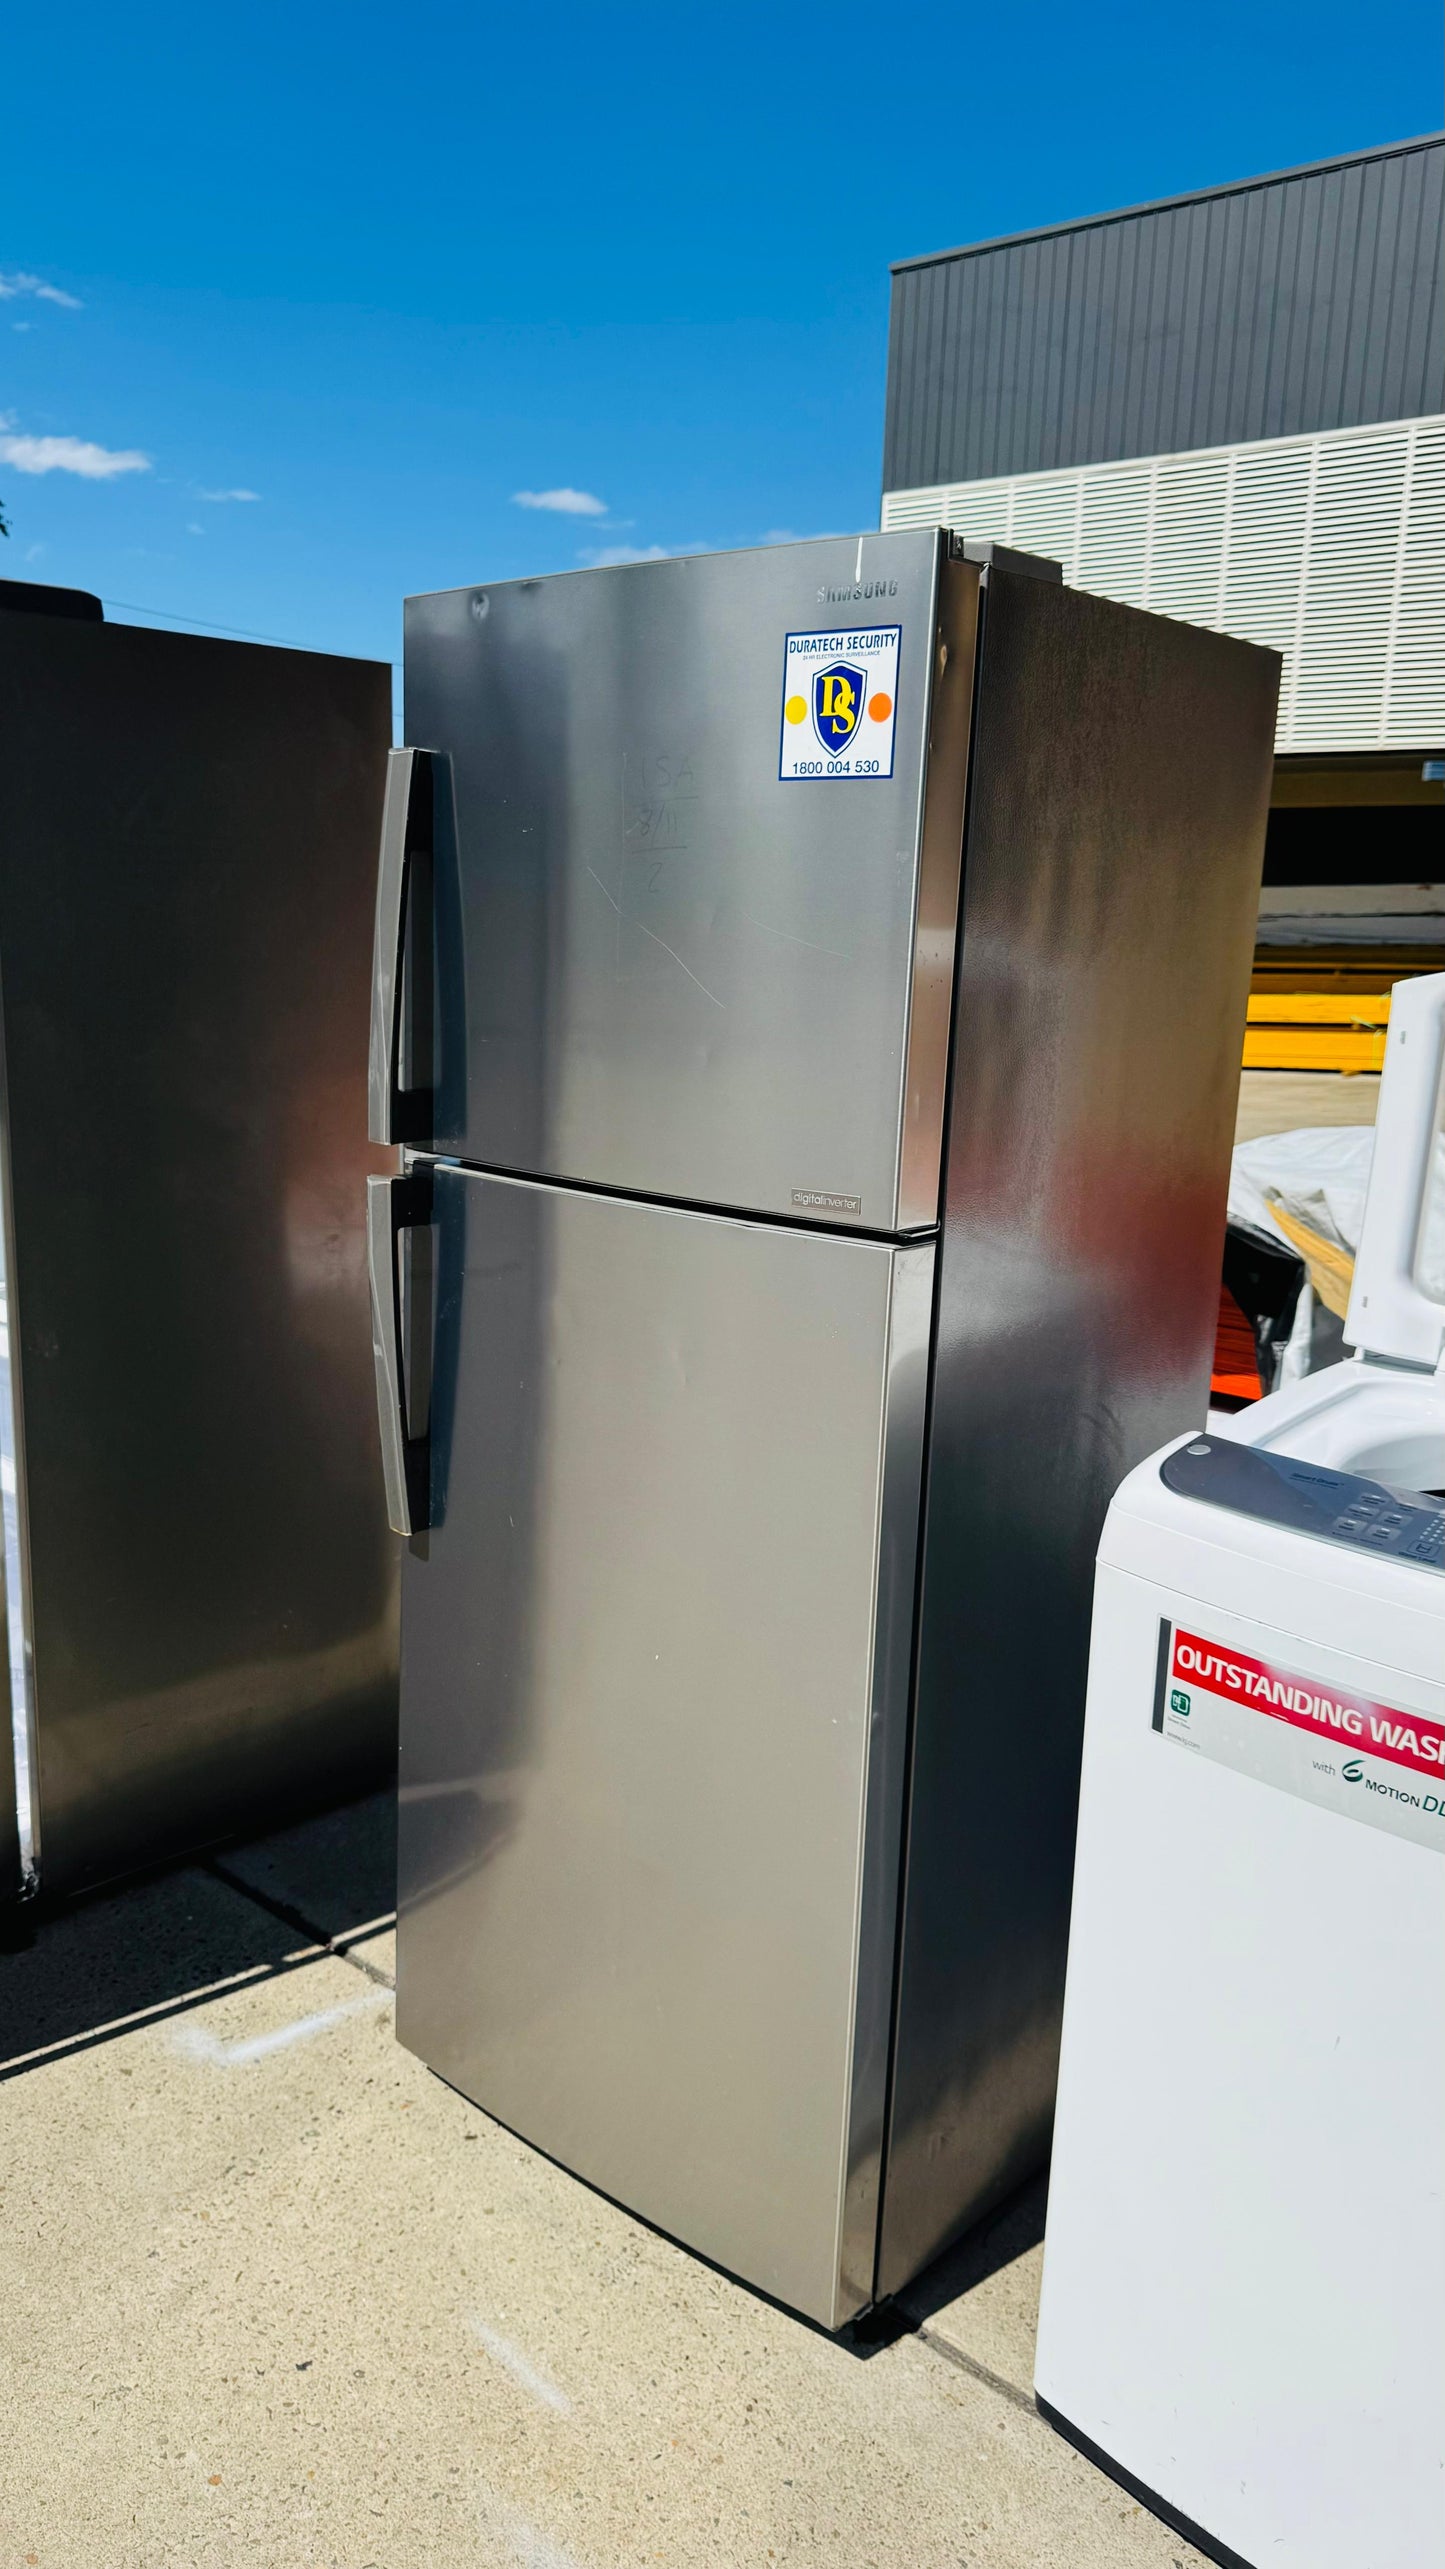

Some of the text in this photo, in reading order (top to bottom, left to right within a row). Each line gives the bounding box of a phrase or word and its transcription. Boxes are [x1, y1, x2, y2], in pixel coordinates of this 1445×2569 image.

[816, 579, 898, 604] SAMSUNG
[789, 633, 897, 653] DURATECH SECURITY
[816, 652, 845, 660] ELECTRONIC
[846, 650, 880, 658] SURVEILLANCE
[820, 675, 855, 734] DS
[793, 760, 879, 774] 1800 004 530
[1177, 1645, 1362, 1735] OUTSTANDING
[1312, 1759, 1336, 1776] with
[1365, 1779, 1420, 1807] MOTION
